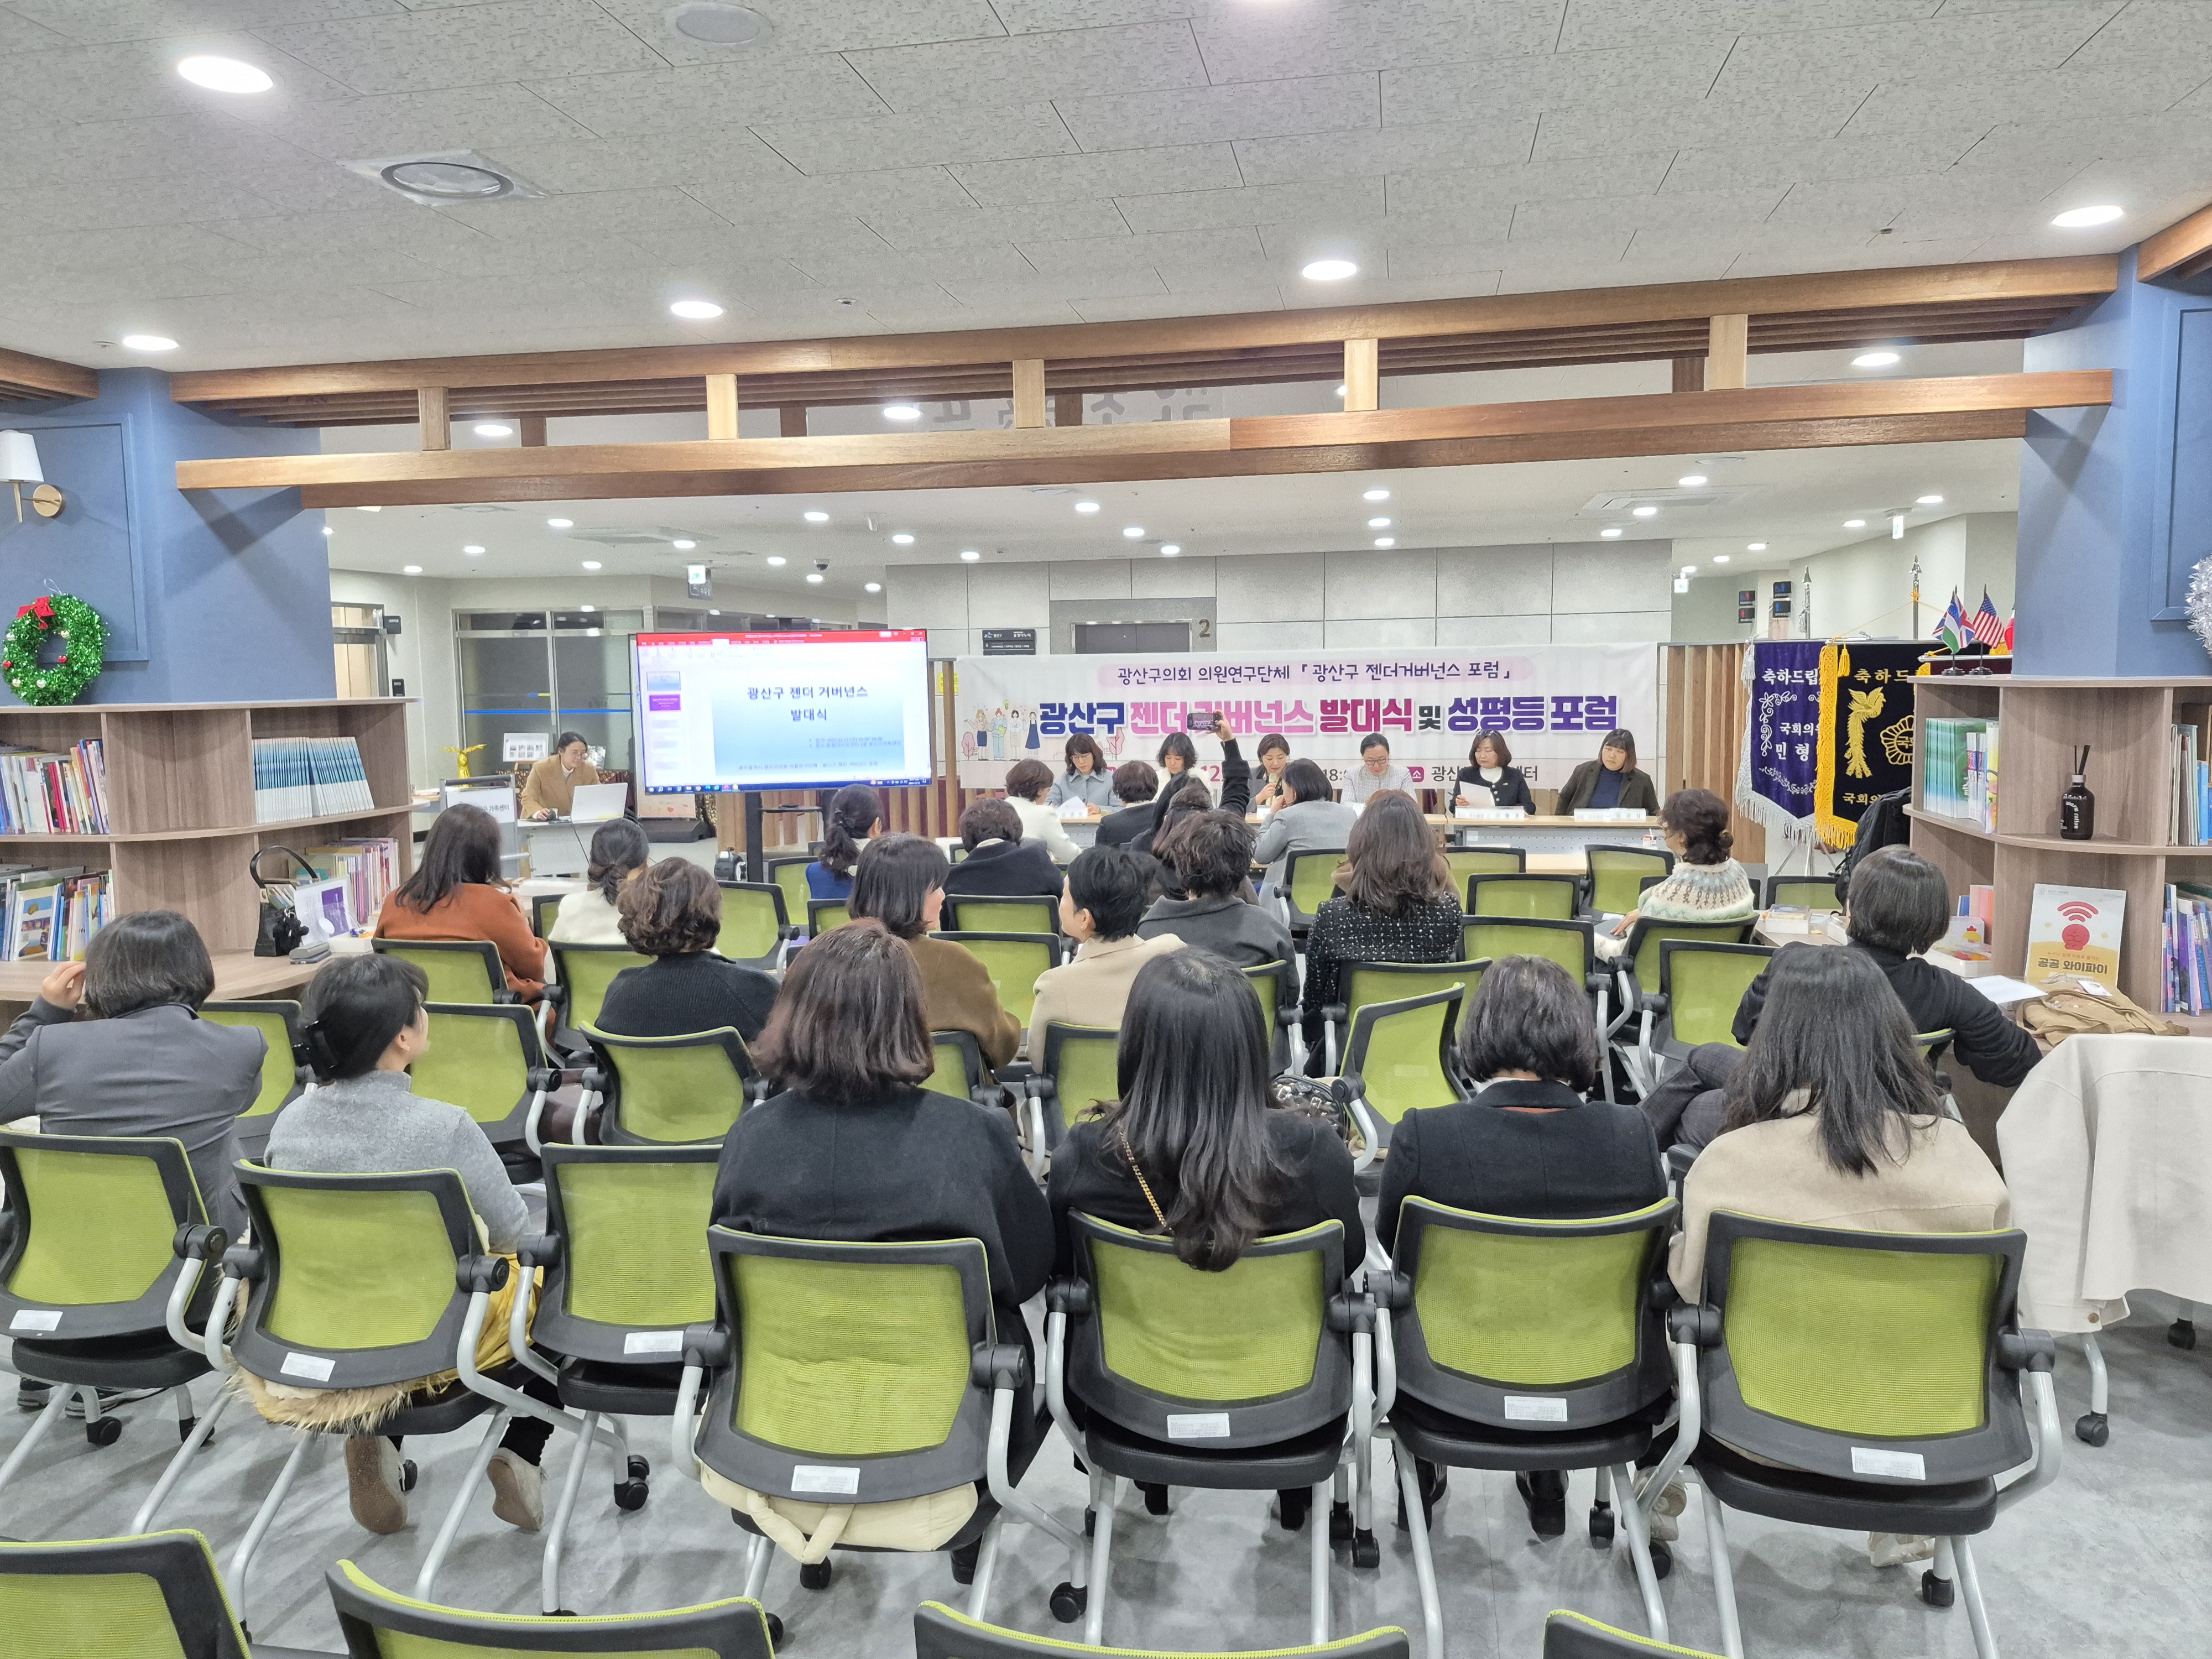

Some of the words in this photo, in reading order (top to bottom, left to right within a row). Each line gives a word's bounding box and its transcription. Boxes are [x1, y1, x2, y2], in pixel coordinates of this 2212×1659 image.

[1198, 619, 1211, 638] 2
[1118, 667, 1191, 685] 광산구의회
[1198, 665, 1290, 684] 의원연구단체
[1365, 662, 1461, 681] 젠더거버넌스
[1762, 667, 1819, 686] 축하드립
[1854, 668, 1910, 684] 축하드
[747, 687, 785, 700] 광산구
[790, 686, 813, 699] 젠더
[818, 686, 868, 698] 거버넌스
[790, 708, 827, 722] 발대식
[1039, 702, 1125, 735] 광산구
[1320, 698, 1412, 732] 발대식
[1418, 706, 1441, 731] 및
[1448, 696, 1545, 732] 성평등
[1550, 695, 1618, 731] 포럼
[2038, 957, 2060, 969] 공공
[2063, 960, 2108, 974] 와이파이
